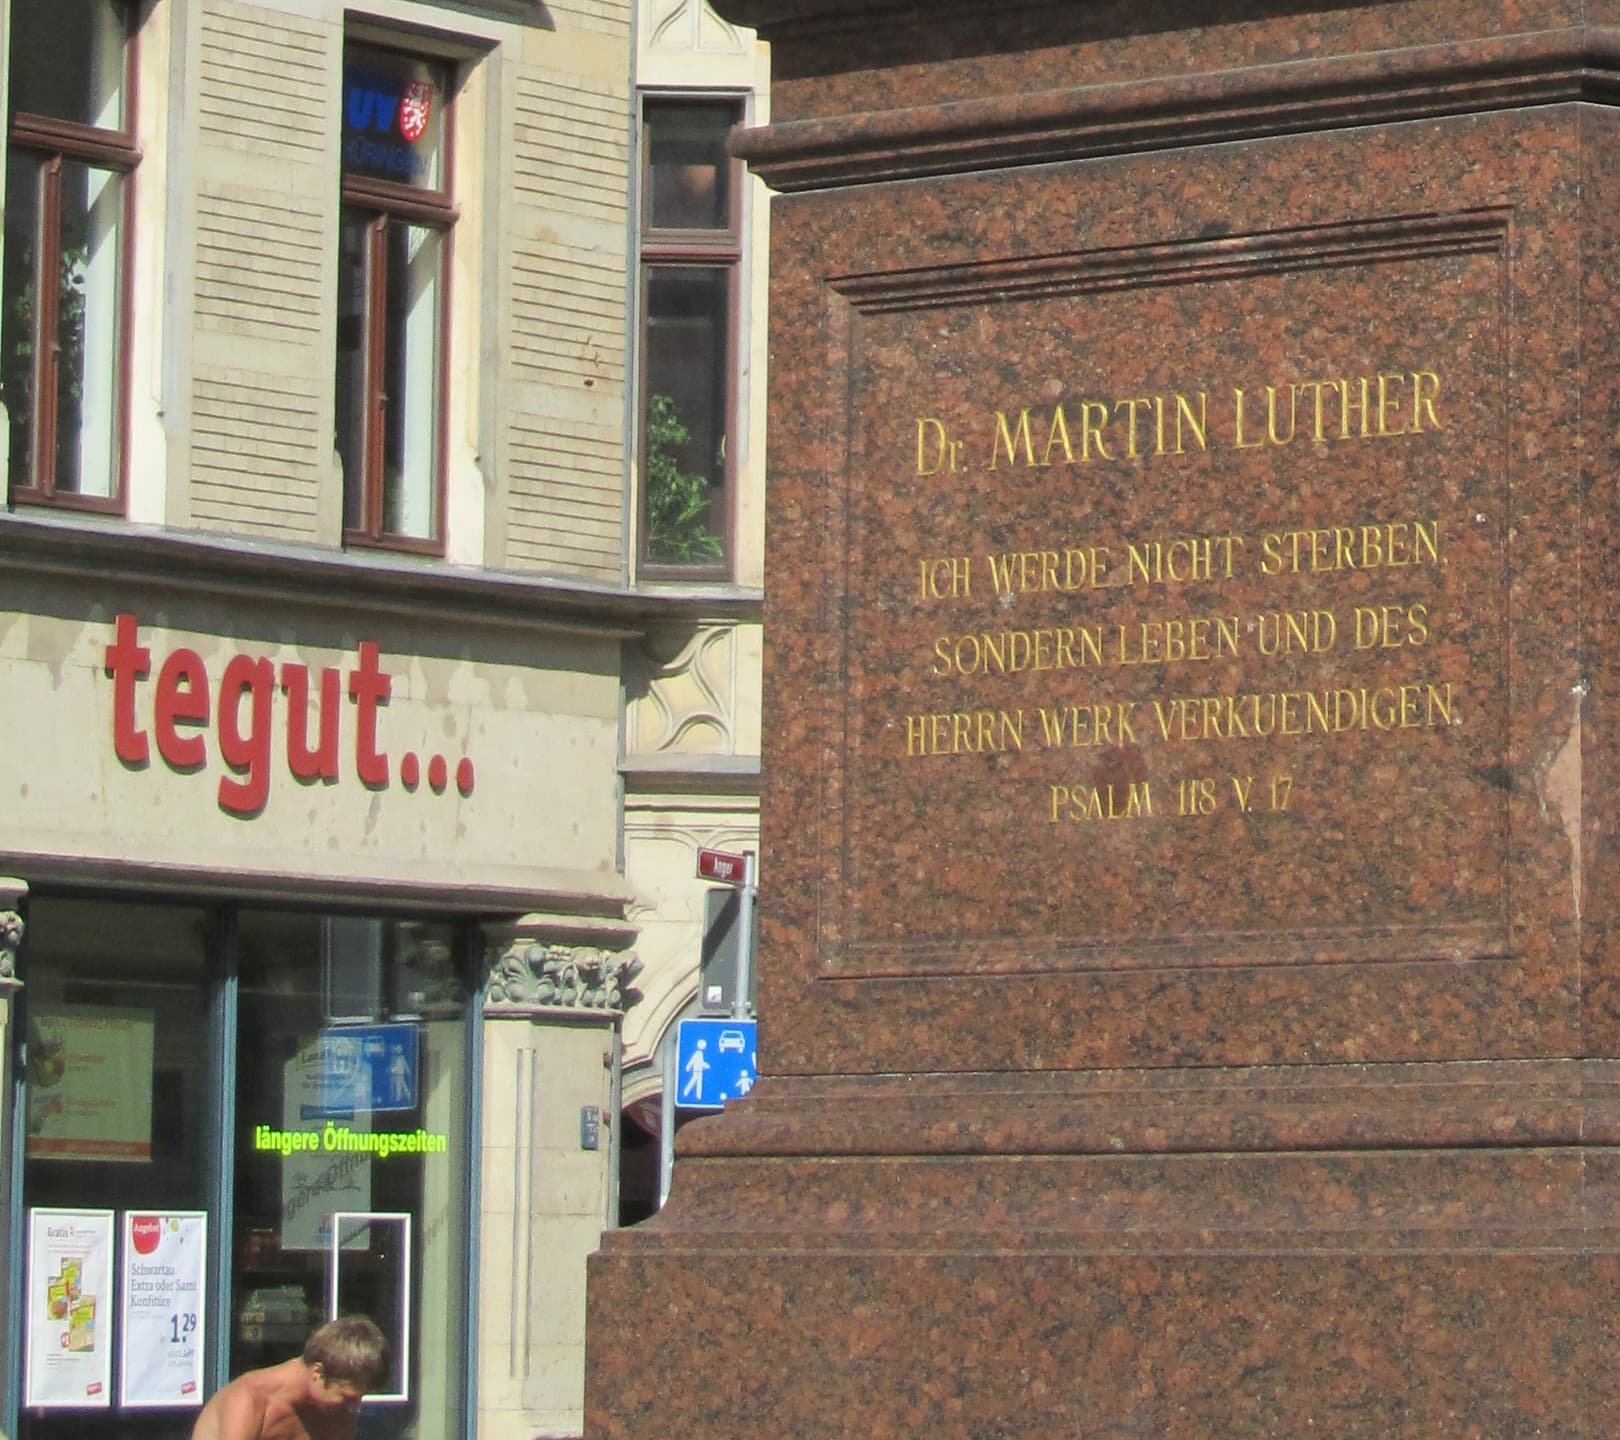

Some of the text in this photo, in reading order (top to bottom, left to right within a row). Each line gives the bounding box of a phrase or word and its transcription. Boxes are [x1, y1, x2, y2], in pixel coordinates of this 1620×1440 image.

[915, 371, 1441, 477] Dr. MARTIN LUTHER
[919, 556, 972, 600] ICH
[987, 546, 1112, 594] WERDE
[1126, 535, 1243, 585] NICHT
[932, 604, 1429, 677] SONDERN LEBEN UND DES
[907, 708, 1023, 756] HERRN
[1038, 702, 1137, 747] WERK
[1050, 775, 1294, 822] PSALM 118 V. 17
[713, 856, 734, 878] Anger
[255, 1120, 447, 1158] längere Öffnungszeiten
[130, 1279, 153, 1291] Extra
[155, 1279, 174, 1291] oder
[170, 1313, 197, 1344] 1.29
